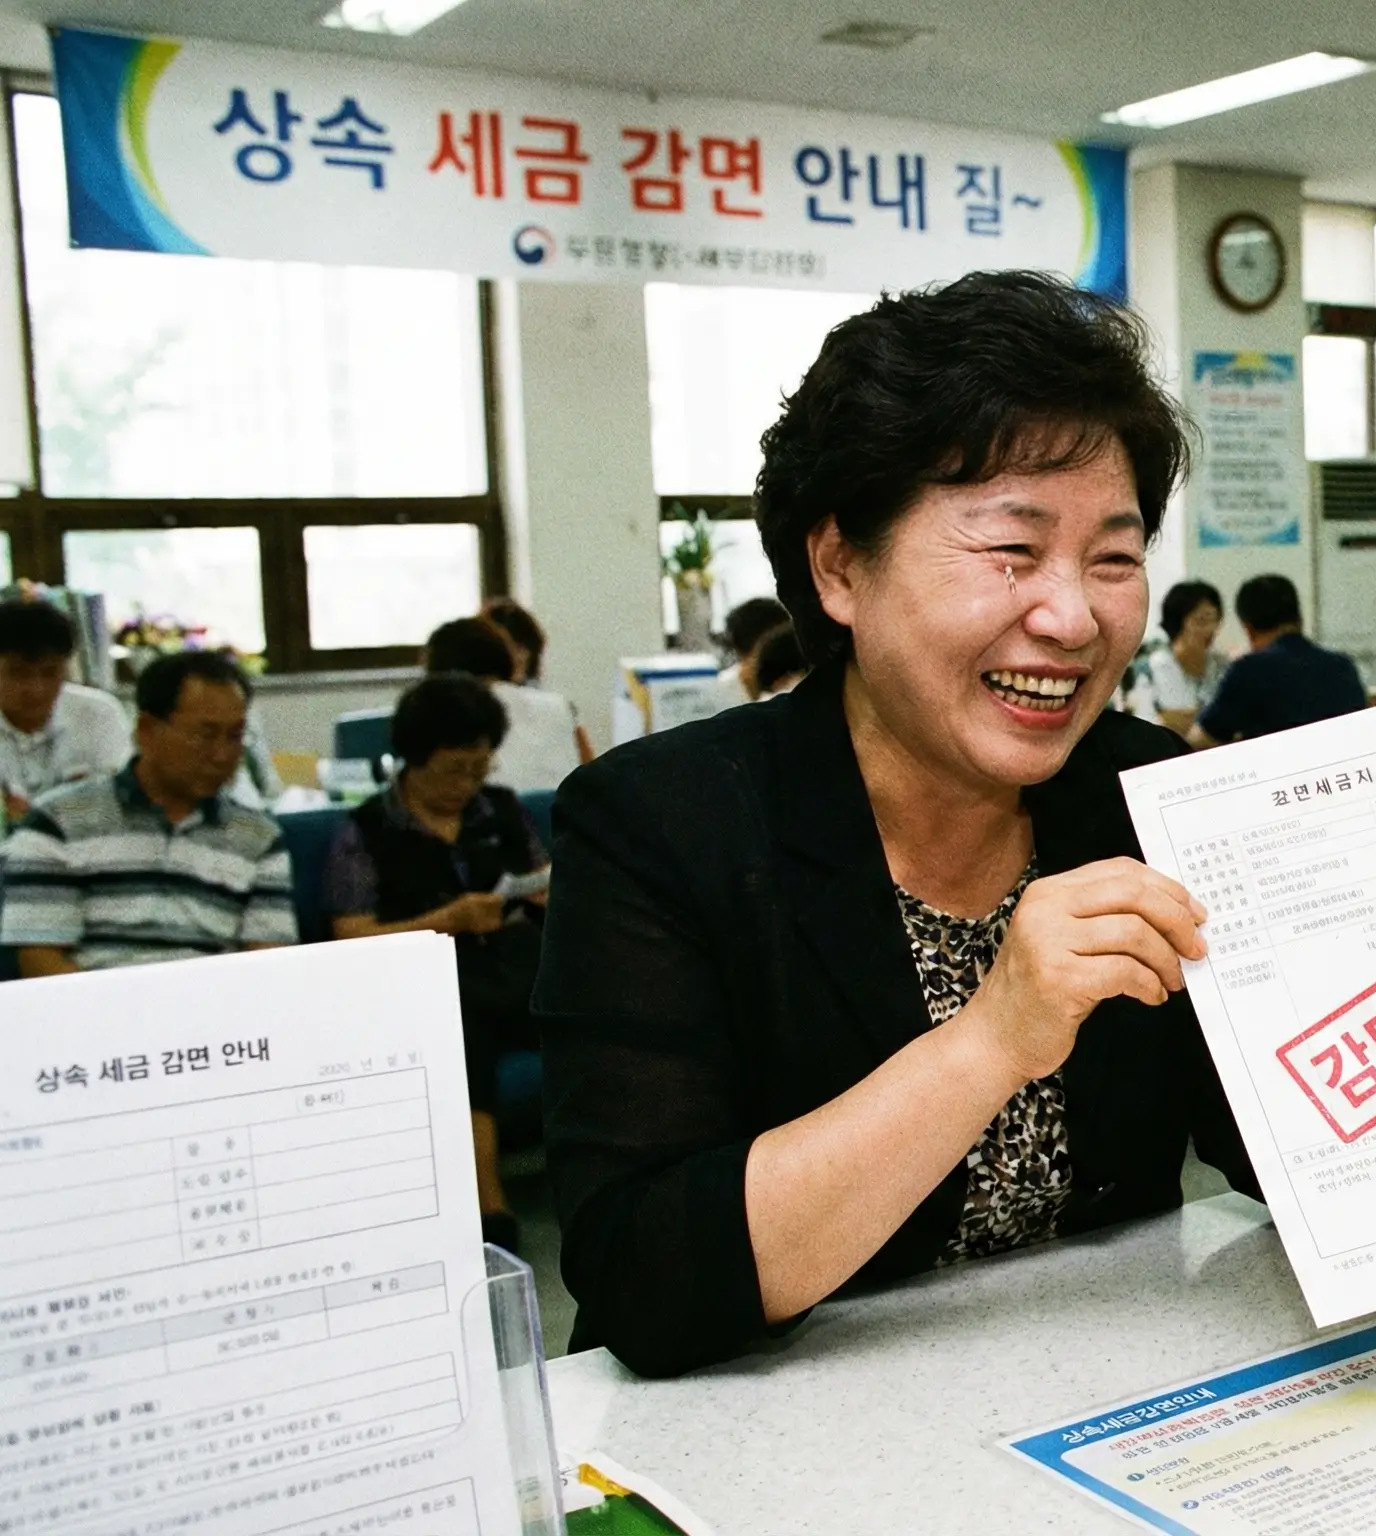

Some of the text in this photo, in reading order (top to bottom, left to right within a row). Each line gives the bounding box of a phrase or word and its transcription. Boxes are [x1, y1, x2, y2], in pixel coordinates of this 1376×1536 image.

[213, 87, 395, 190] 상속
[428, 110, 590, 206] 세금
[621, 127, 764, 219] 감면
[795, 145, 926, 230] 안내
[35, 1037, 270, 1094] 상속 세금 감면 안내
